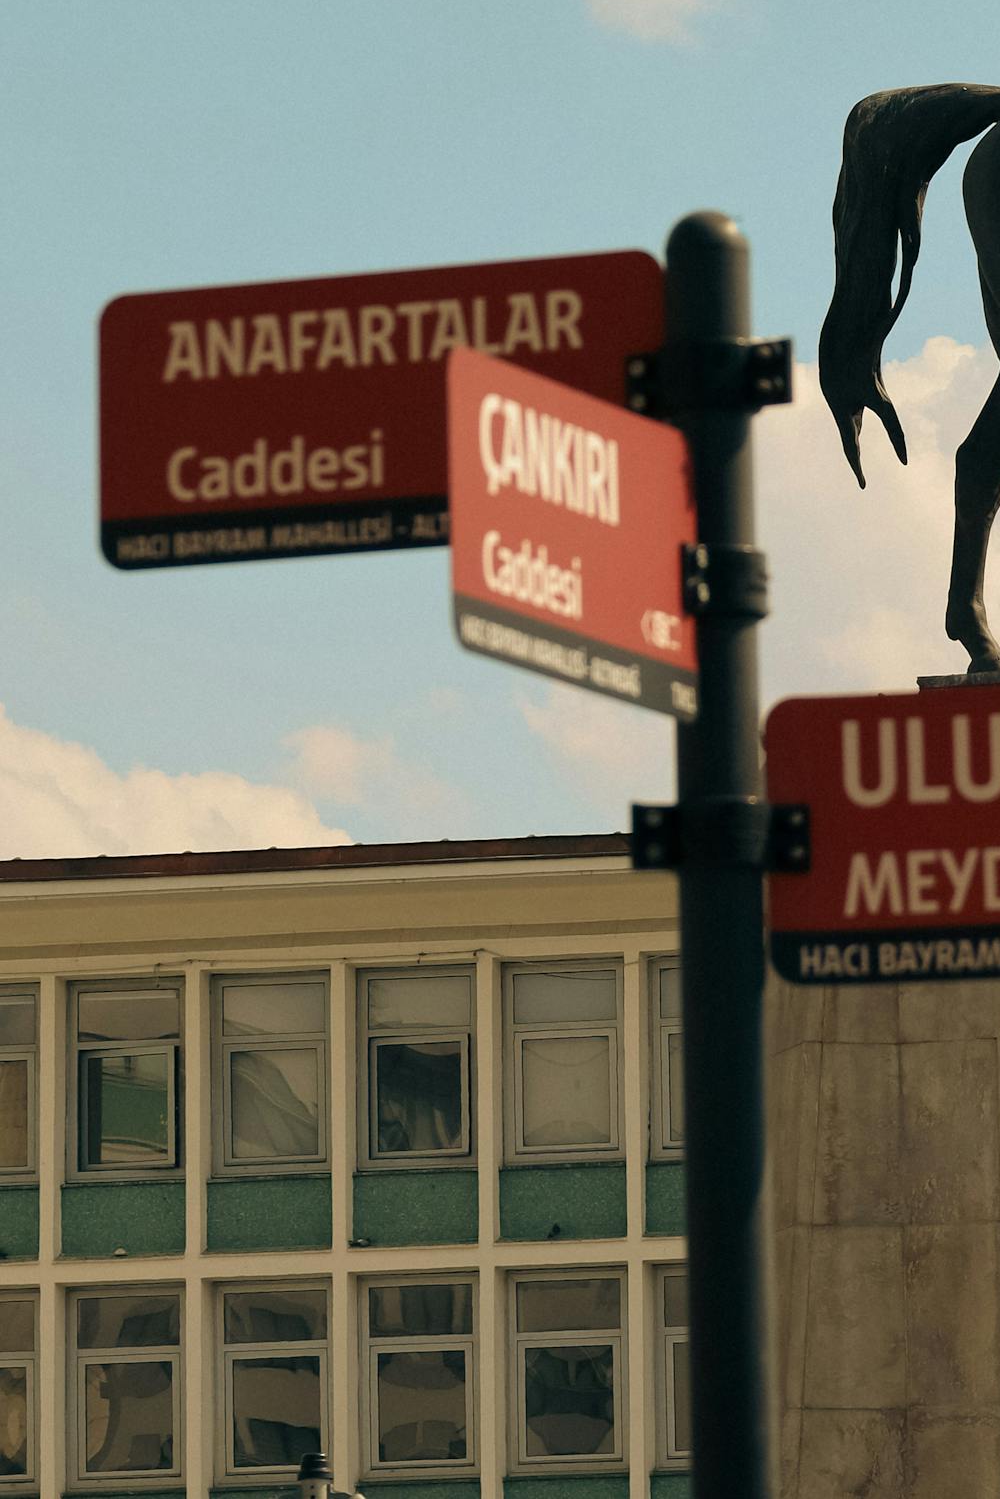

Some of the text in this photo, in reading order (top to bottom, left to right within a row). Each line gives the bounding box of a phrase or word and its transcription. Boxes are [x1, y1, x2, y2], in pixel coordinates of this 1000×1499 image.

[162, 289, 584, 383] ANAFARTALAR
[166, 427, 385, 502] Caddesi
[478, 392, 622, 527] ÇANKIRI
[481, 529, 585, 622] Caddesi
[800, 942, 870, 978] HACI
